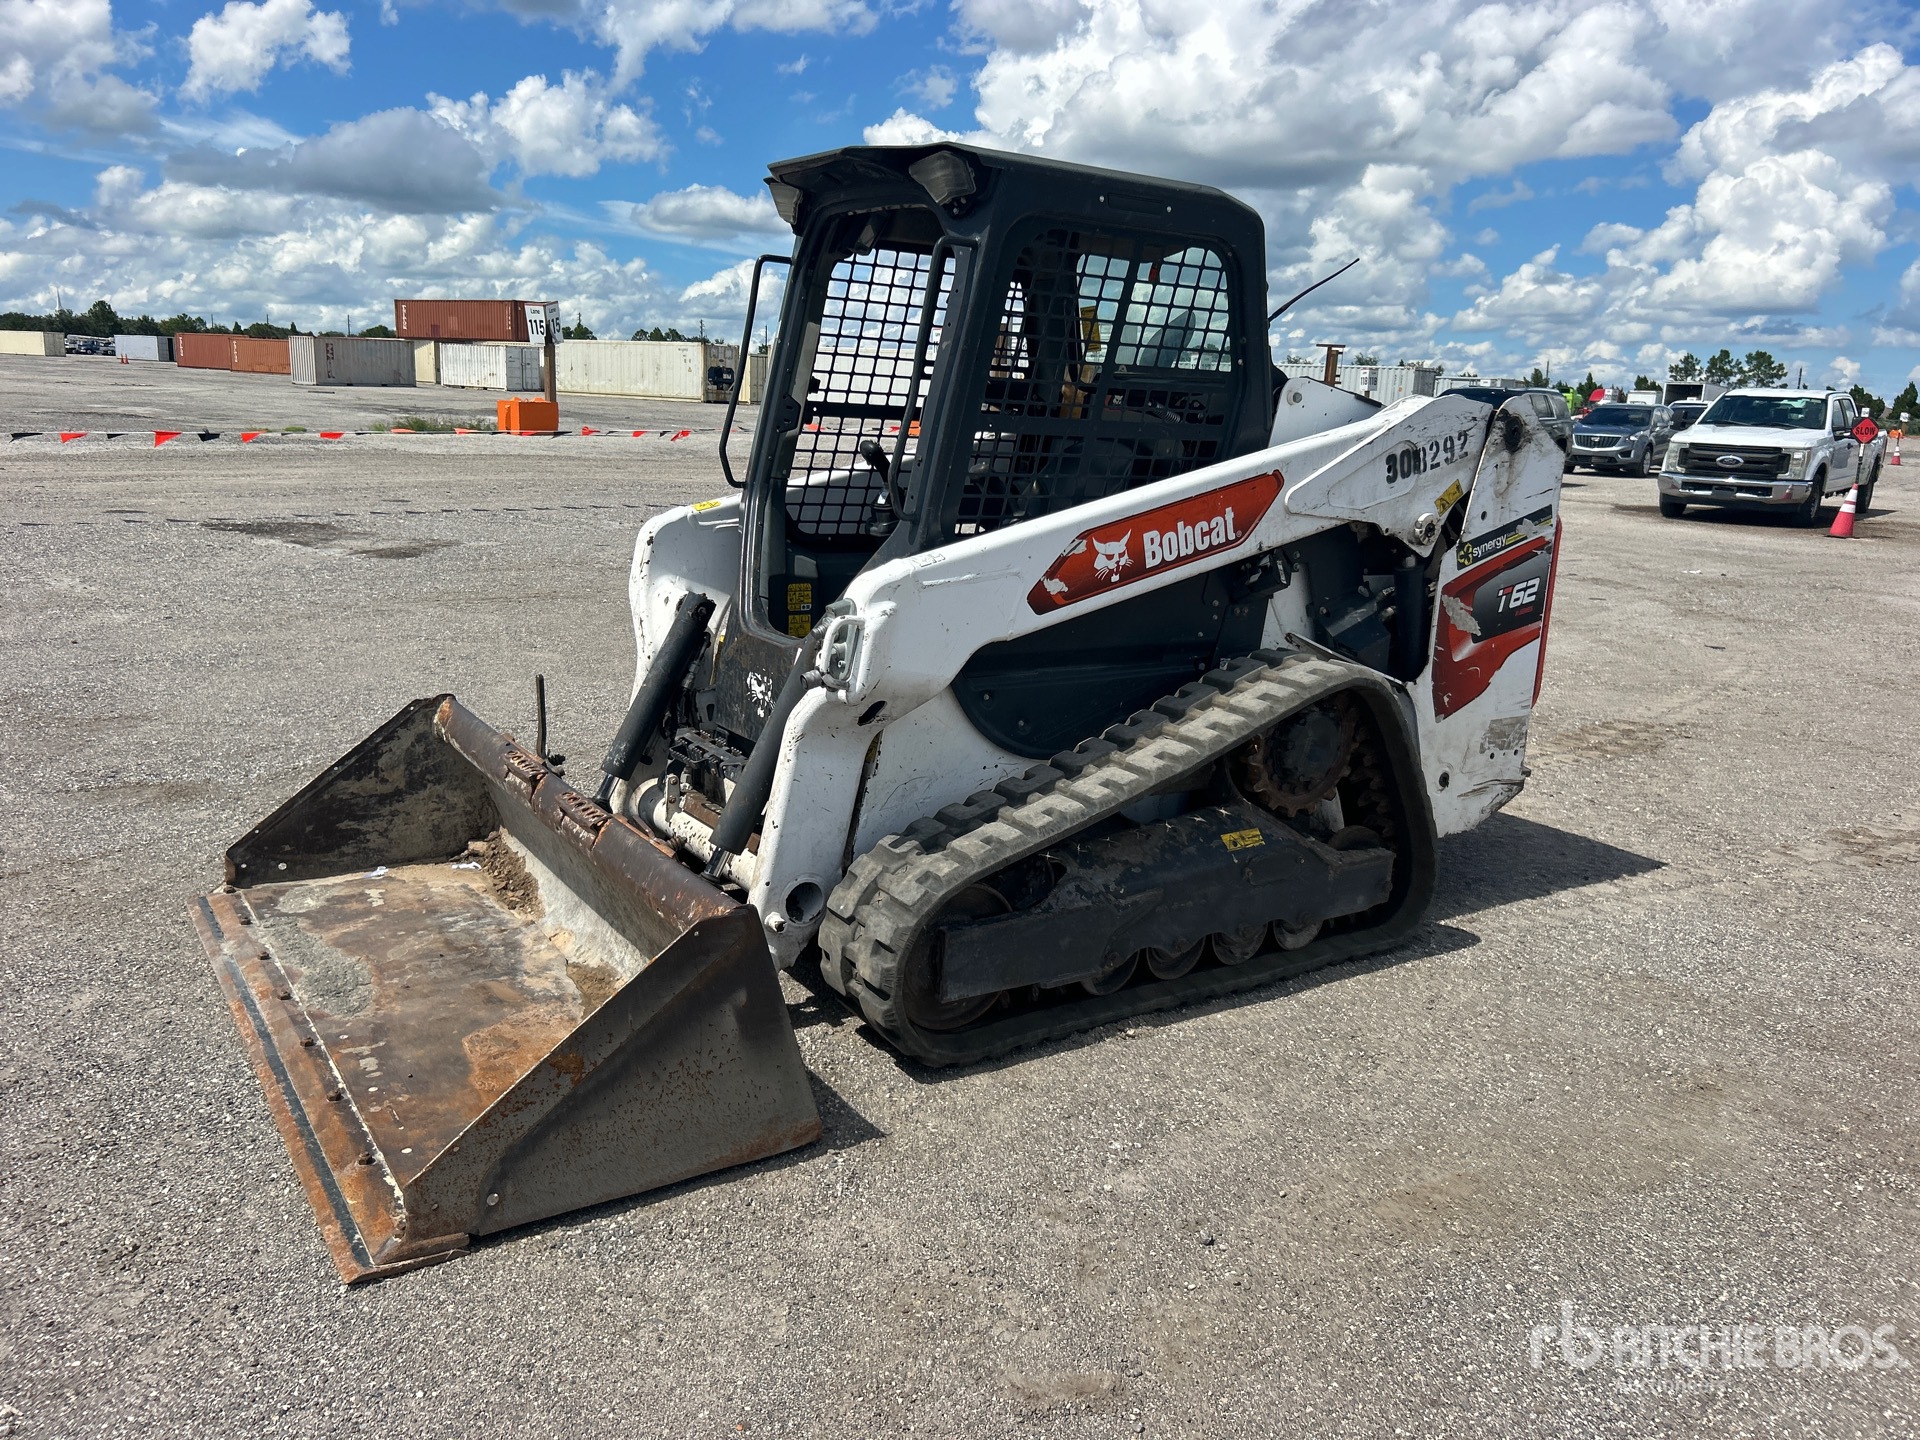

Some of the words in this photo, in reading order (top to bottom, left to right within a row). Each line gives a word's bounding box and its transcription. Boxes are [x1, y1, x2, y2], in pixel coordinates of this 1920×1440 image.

[529, 319, 545, 335] 115
[550, 317, 561, 334] 15
[1855, 426, 1876, 435] SLOW
[1143, 506, 1236, 568] Bobcat
[1472, 534, 1508, 558] synergy
